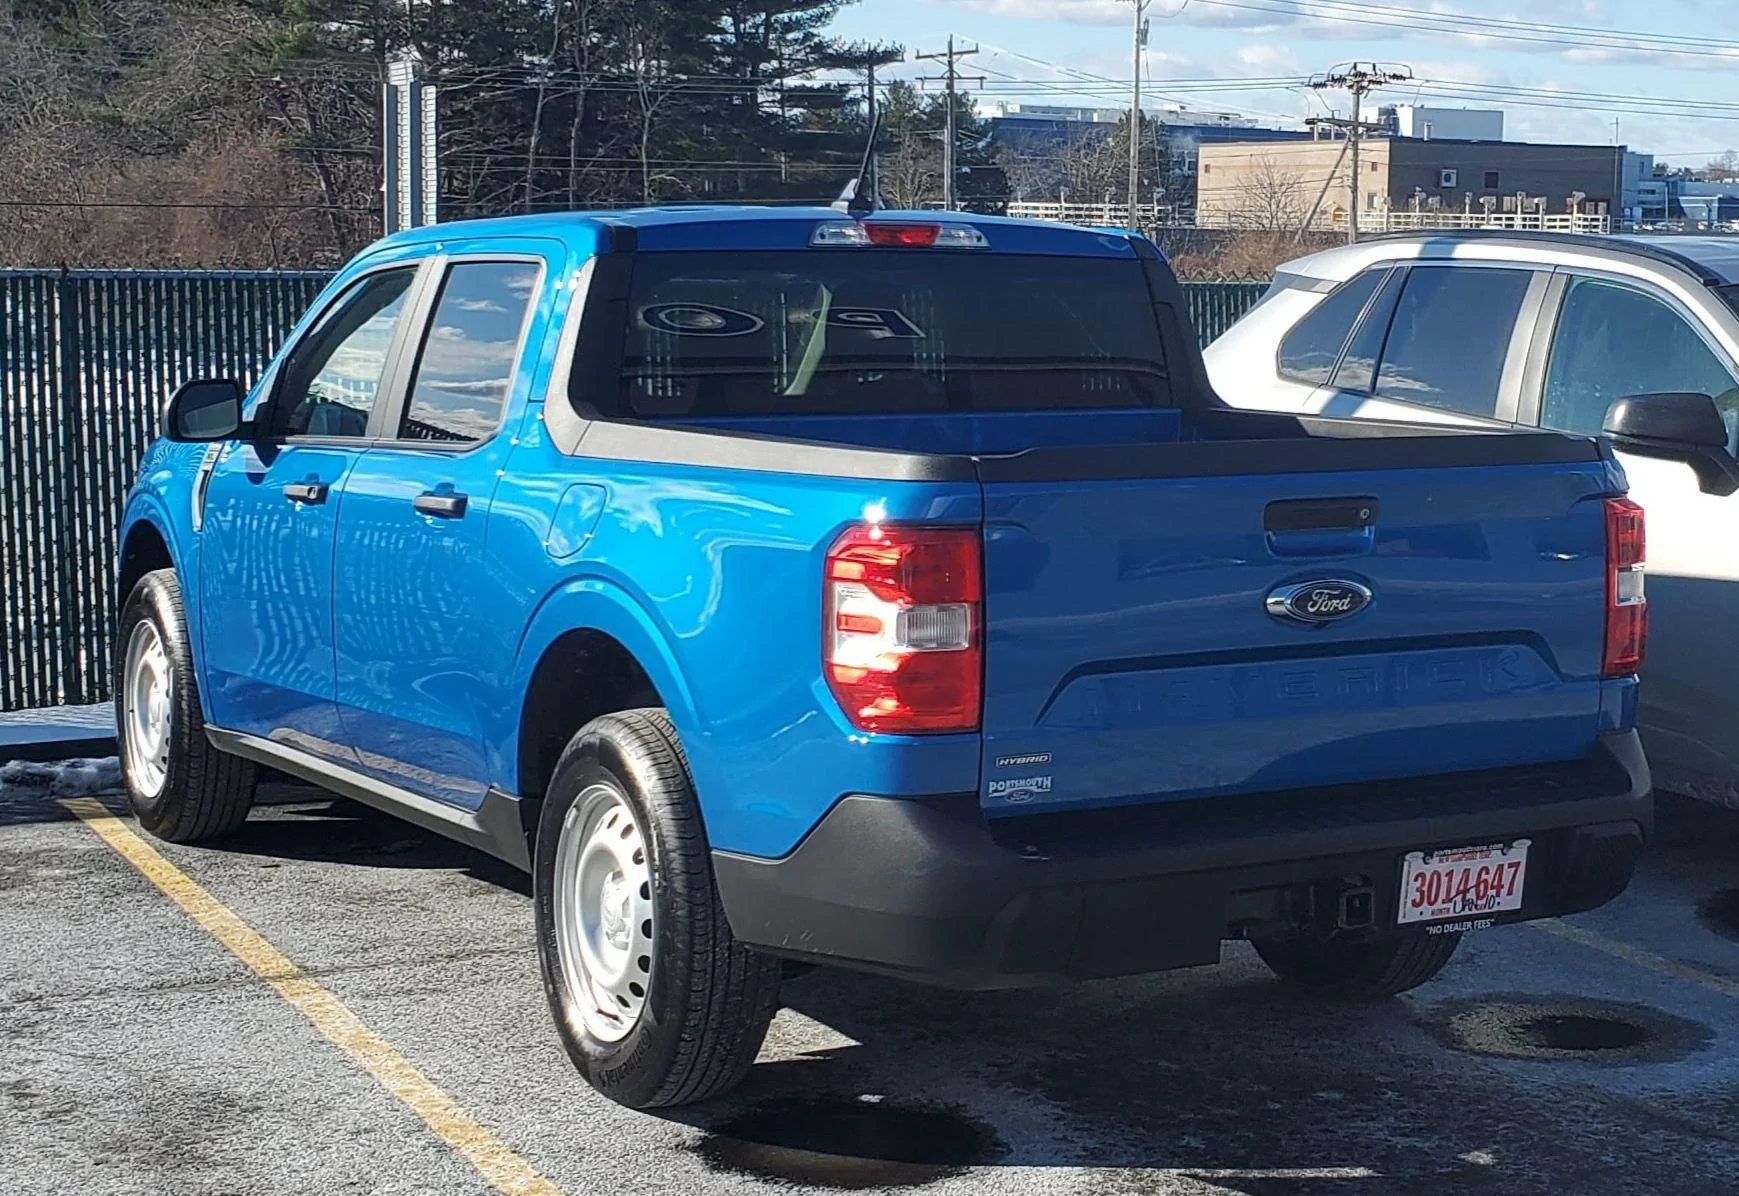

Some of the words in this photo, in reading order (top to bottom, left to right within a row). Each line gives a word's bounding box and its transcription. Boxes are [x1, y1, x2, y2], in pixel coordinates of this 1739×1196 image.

[1307, 589, 1351, 612] Ford
[1085, 650, 1520, 713] MAVERICK
[999, 755, 1049, 765] HYBRID
[988, 776, 1052, 793] PORTSMOUTH
[1411, 861, 1521, 908] 3014647
[1443, 921, 1473, 933] DEALER
